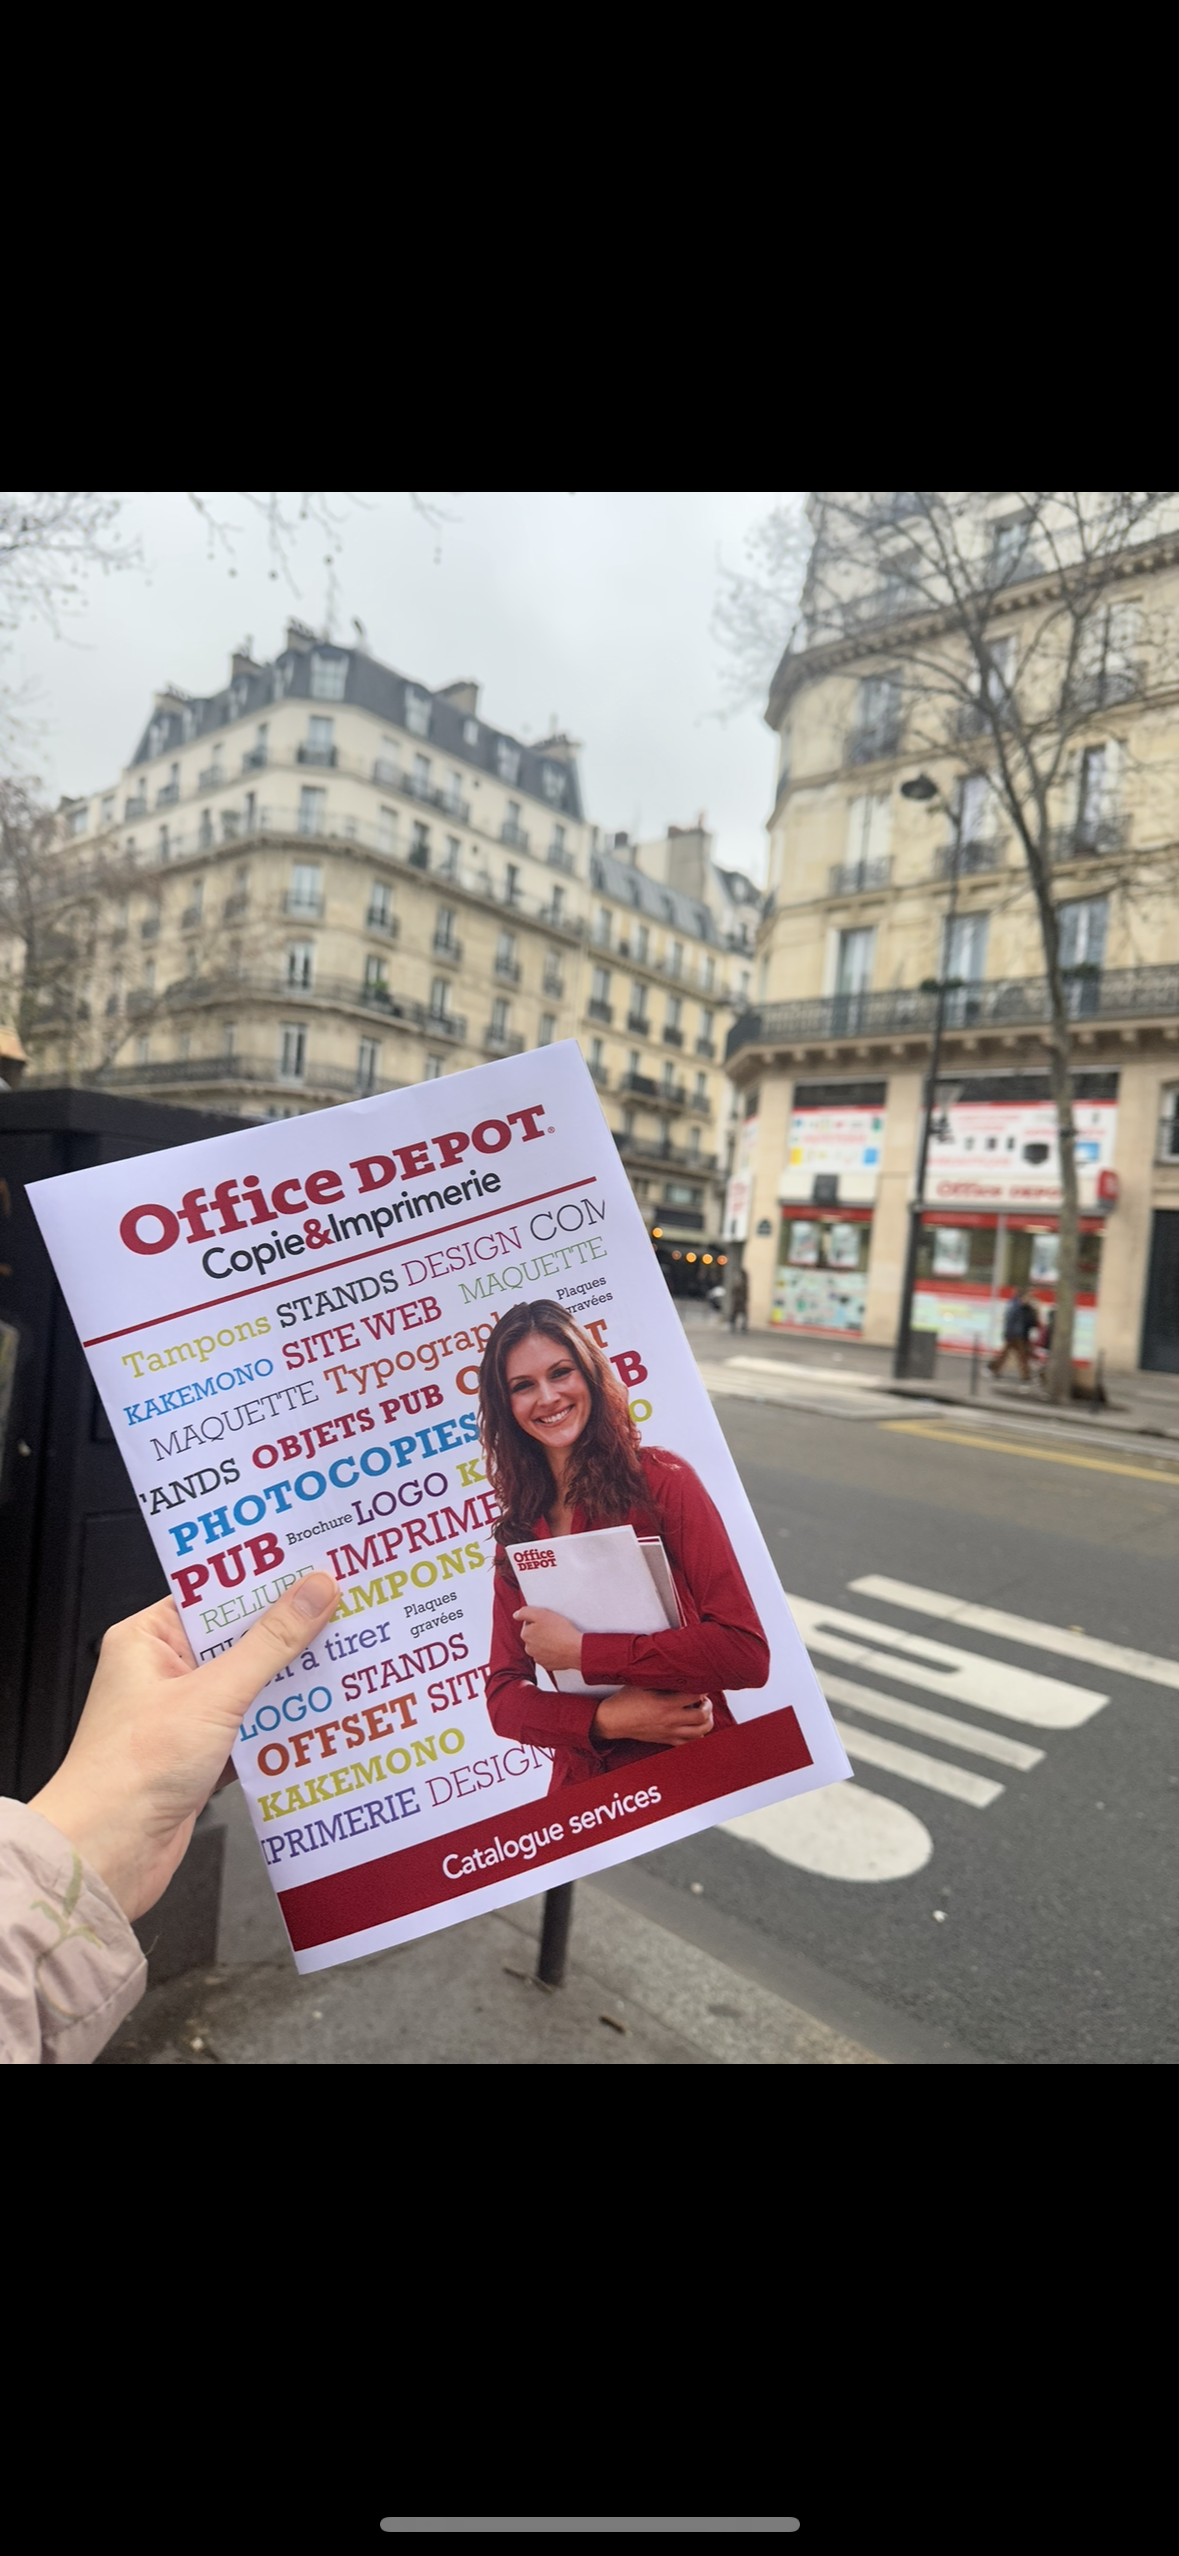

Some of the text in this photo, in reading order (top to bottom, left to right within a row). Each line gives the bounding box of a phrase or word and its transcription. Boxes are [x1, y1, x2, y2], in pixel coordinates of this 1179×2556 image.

[119, 1168, 345, 1256] Office
[202, 1170, 502, 1279] Copie&Imprimerie
[121, 1316, 272, 1379] Tampons
[276, 1269, 399, 1329] STANDS
[401, 1226, 523, 1287] DESIGN
[123, 1236, 608, 1426] KAKEMONO SITE WEB MAQUETTE
[556, 1276, 607, 1300] Plaques
[150, 1311, 501, 1462] MAQUETTE Typograp
[139, 1384, 444, 1516] ANDS OBJETS PUB
[168, 1411, 480, 1557] PHOTOCOPIES
[170, 1472, 448, 1609] PUB Brochure LOGO
[329, 1541, 485, 1623] AMPONS
[513, 1548, 555, 1563] Office
[517, 1558, 558, 1571] DEPOT
[324, 1621, 391, 1661] tirer
[403, 1591, 458, 1618] Plaques
[410, 1608, 464, 1638] gravées
[239, 1686, 333, 1742] LOGO
[341, 1632, 469, 1702] STANDS
[257, 1692, 418, 1776] OFFSET
[257, 1727, 466, 1822] KAKEMONO
[425, 1744, 555, 1807] DESIGN
[442, 1785, 662, 1879] Catalogue services
